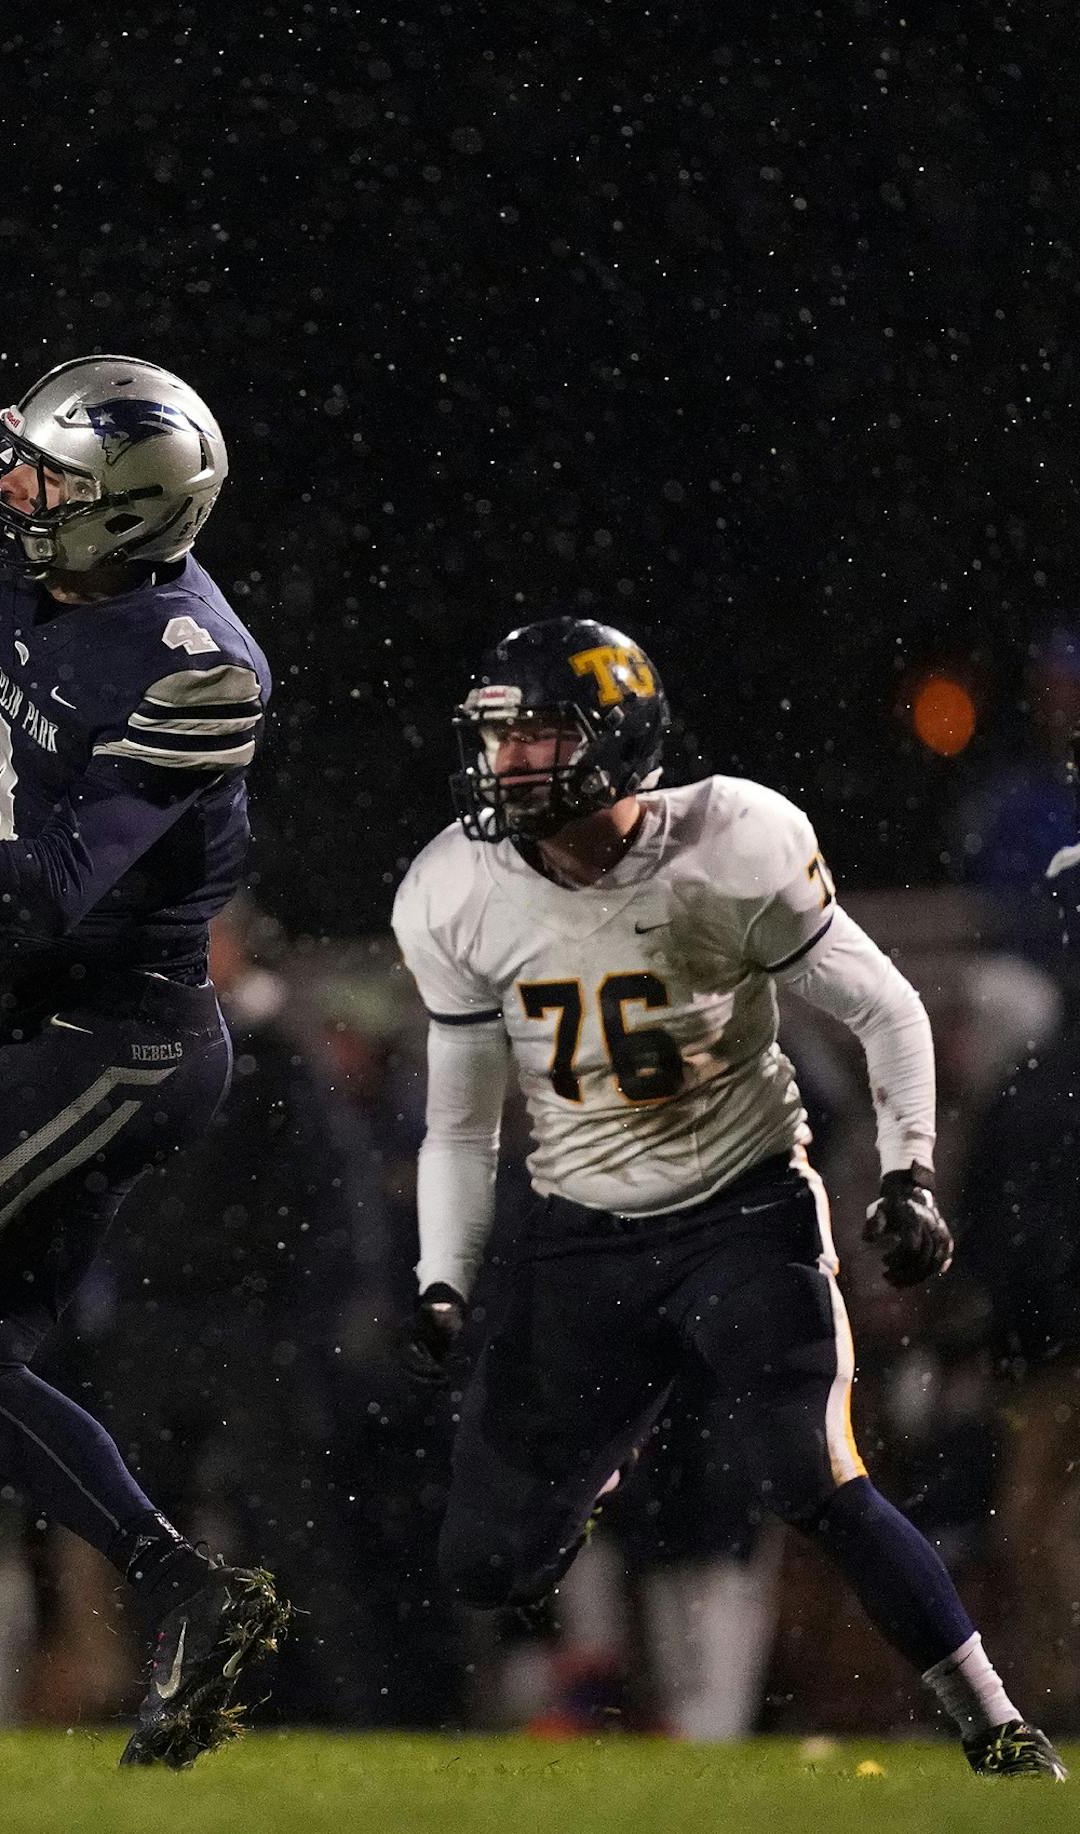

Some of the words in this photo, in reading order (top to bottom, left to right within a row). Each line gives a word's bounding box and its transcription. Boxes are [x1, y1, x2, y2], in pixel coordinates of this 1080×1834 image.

[161, 615, 221, 656] 4
[568, 645, 656, 706] TG
[21, 700, 59, 753] PARK
[131, 1041, 183, 1061] REBELS
[516, 969, 685, 1105] 76
